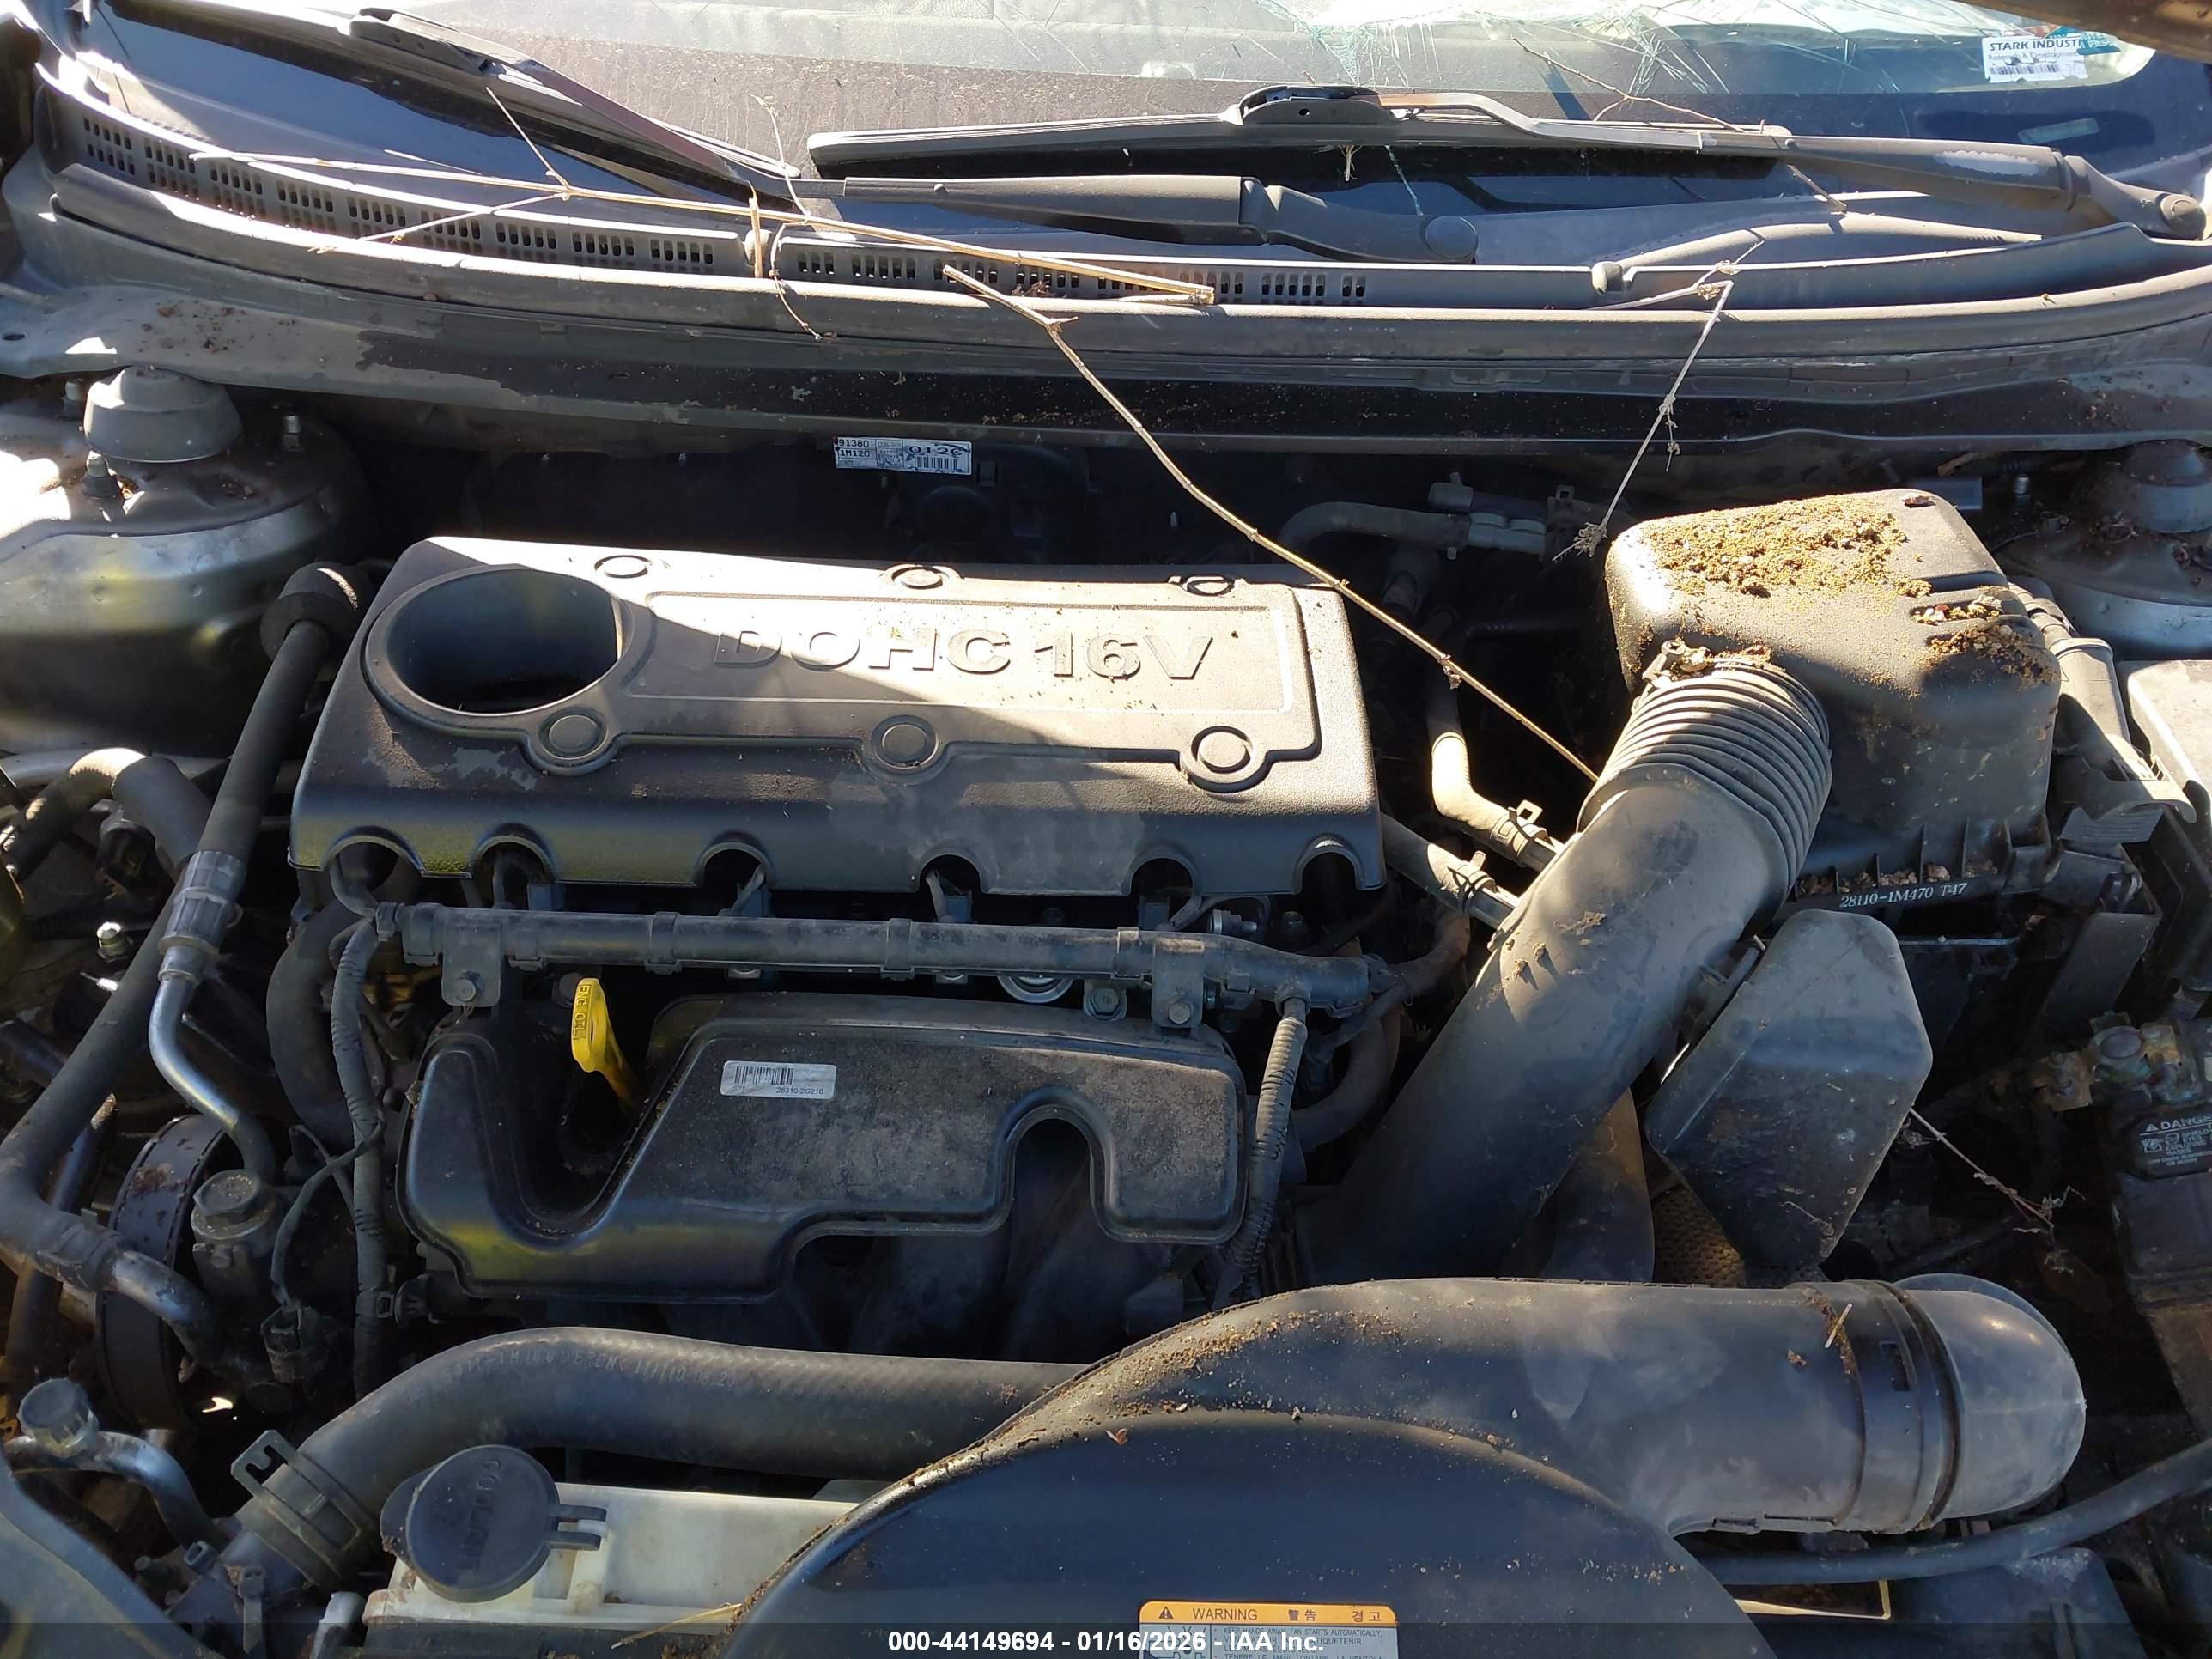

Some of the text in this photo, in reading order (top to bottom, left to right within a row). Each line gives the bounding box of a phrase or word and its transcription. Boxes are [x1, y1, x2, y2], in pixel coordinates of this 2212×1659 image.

[1990, 41, 2029, 51] STARK
[838, 439, 870, 448] 91380
[841, 449, 871, 458] 1M120
[714, 628, 1214, 680] DOHC 16V
[1839, 886, 1934, 908] 28110-1M470
[573, 984, 591, 1041] ENG OIL
[775, 1086, 824, 1096] 28310-2G210
[1192, 1607, 1382, 1623] WARNING 警告 경고
